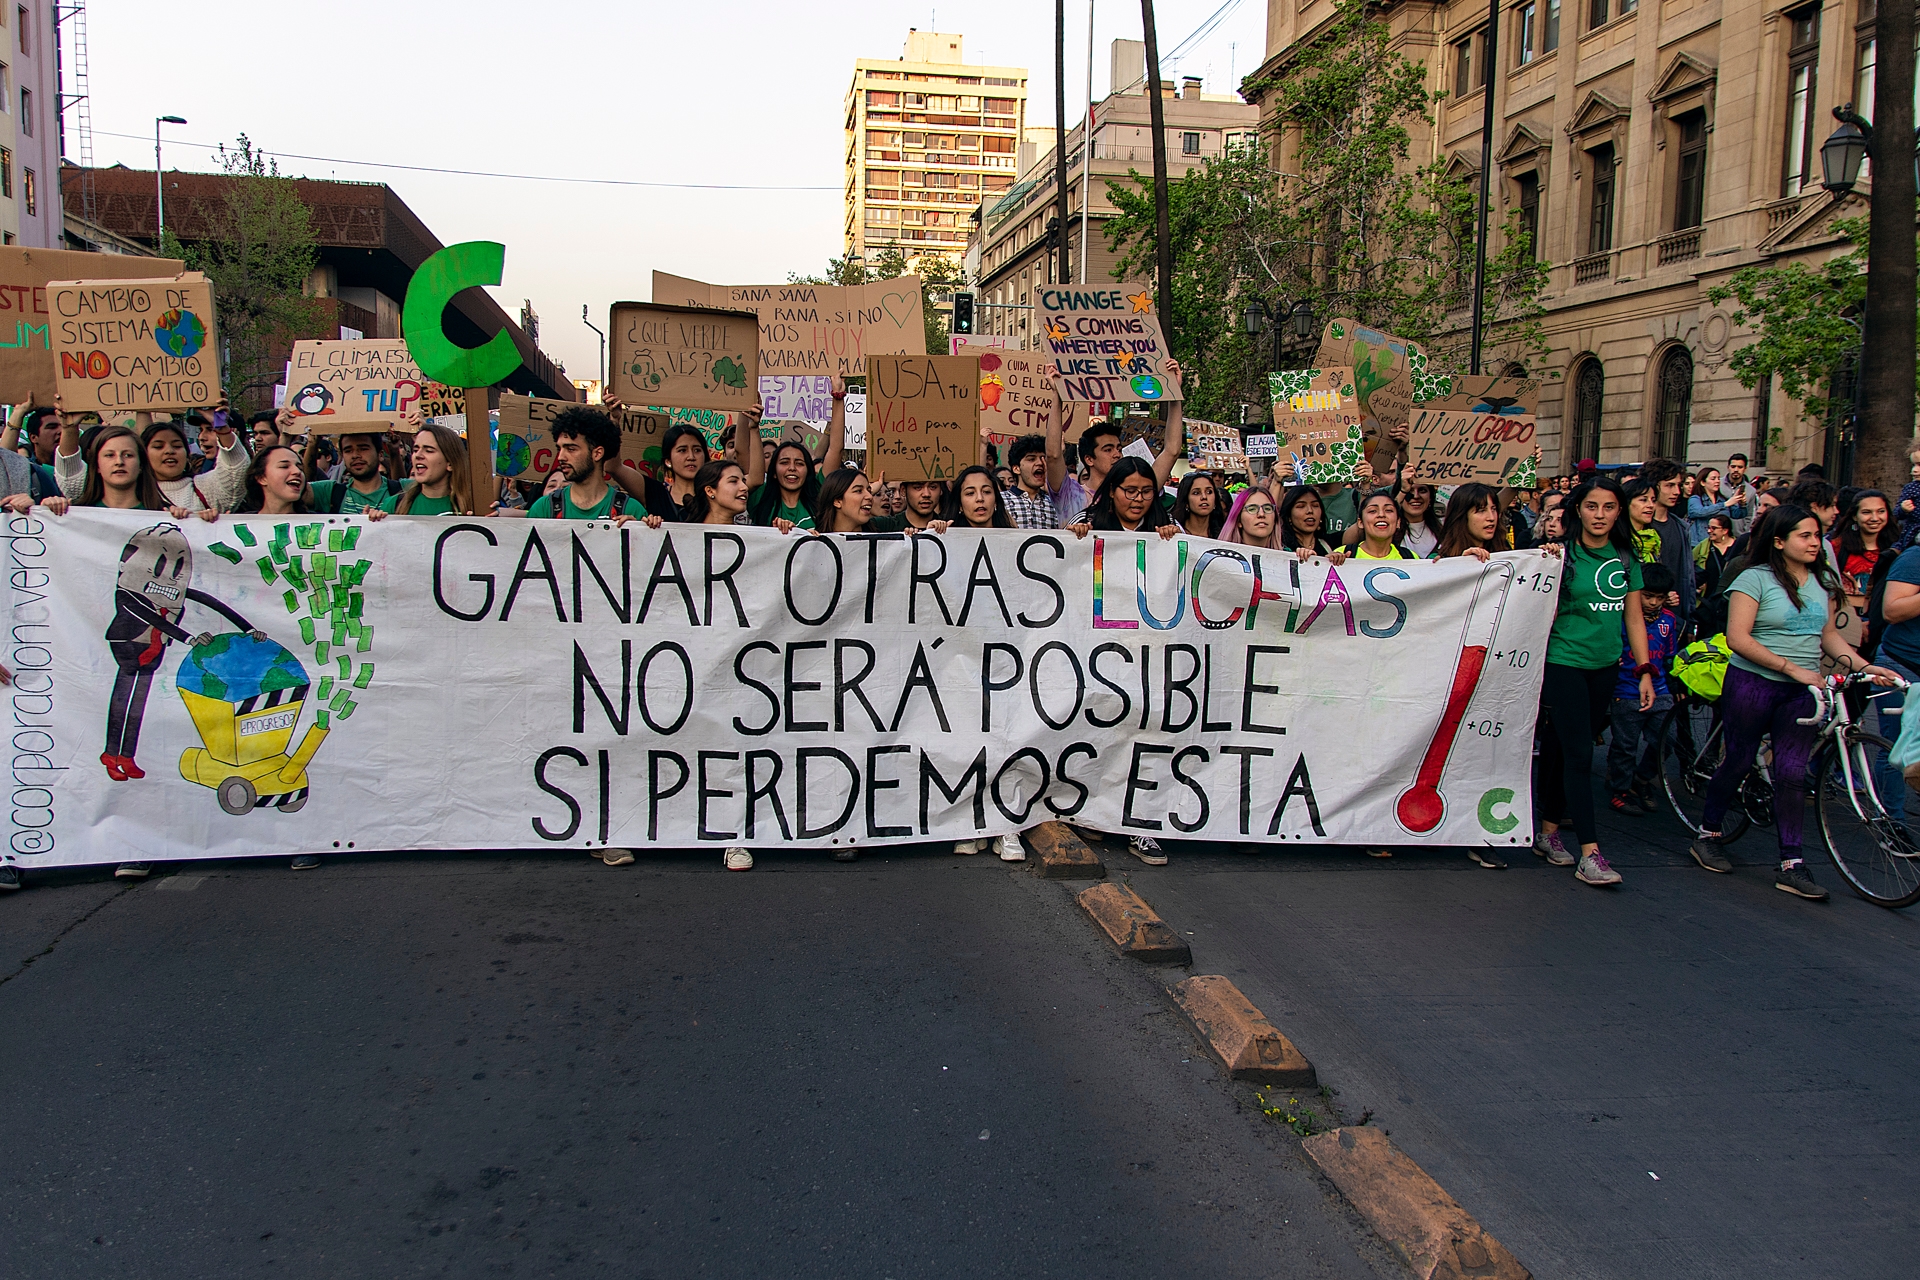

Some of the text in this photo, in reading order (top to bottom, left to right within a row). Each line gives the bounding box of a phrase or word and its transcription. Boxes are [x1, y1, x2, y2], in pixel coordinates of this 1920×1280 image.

[56, 288, 192, 317] CAMBIO DE
[732, 288, 817, 303] SANA SANA
[858, 306, 883, 325] NO
[1046, 315, 1070, 333] IS
[61, 319, 153, 344] SISTEMA
[628, 317, 732, 350] ¿QUÉ VERDE
[813, 326, 863, 358] HOY
[1049, 339, 1157, 354] WHETHER YOU
[60, 350, 202, 379] NO CAMBIO
[298, 352, 320, 368] EL
[1007, 360, 1030, 373] CUIDA
[1055, 358, 1100, 375] LIKE
[1127, 357, 1153, 375] OR
[877, 359, 946, 399] USA
[1009, 375, 1018, 386] O
[1022, 377, 1035, 388] EL
[97, 378, 208, 406] CLIMÁTICO
[338, 387, 354, 406] Y
[1007, 392, 1020, 402] TE
[1291, 389, 1341, 413] CLIMA
[765, 396, 788, 418] EL
[876, 401, 961, 434] Vida para
[1282, 414, 1350, 429] CAMBIANDO
[1440, 416, 1479, 436] UN
[1473, 416, 1534, 444] GRADO
[877, 436, 953, 460] Proteger la
[1198, 436, 1240, 453] GRETA
[1248, 436, 1277, 446] EL AGUA
[1302, 442, 1327, 457] NO
[1466, 443, 1501, 460] UNA
[433, 523, 1411, 638] GANAR OTRAS LUCHAS
[1588, 599, 1626, 612] verd
[572, 636, 1290, 736] NO SERÁ POSIBLE
[531, 741, 1328, 841] SI PERDEMOS ESTA
